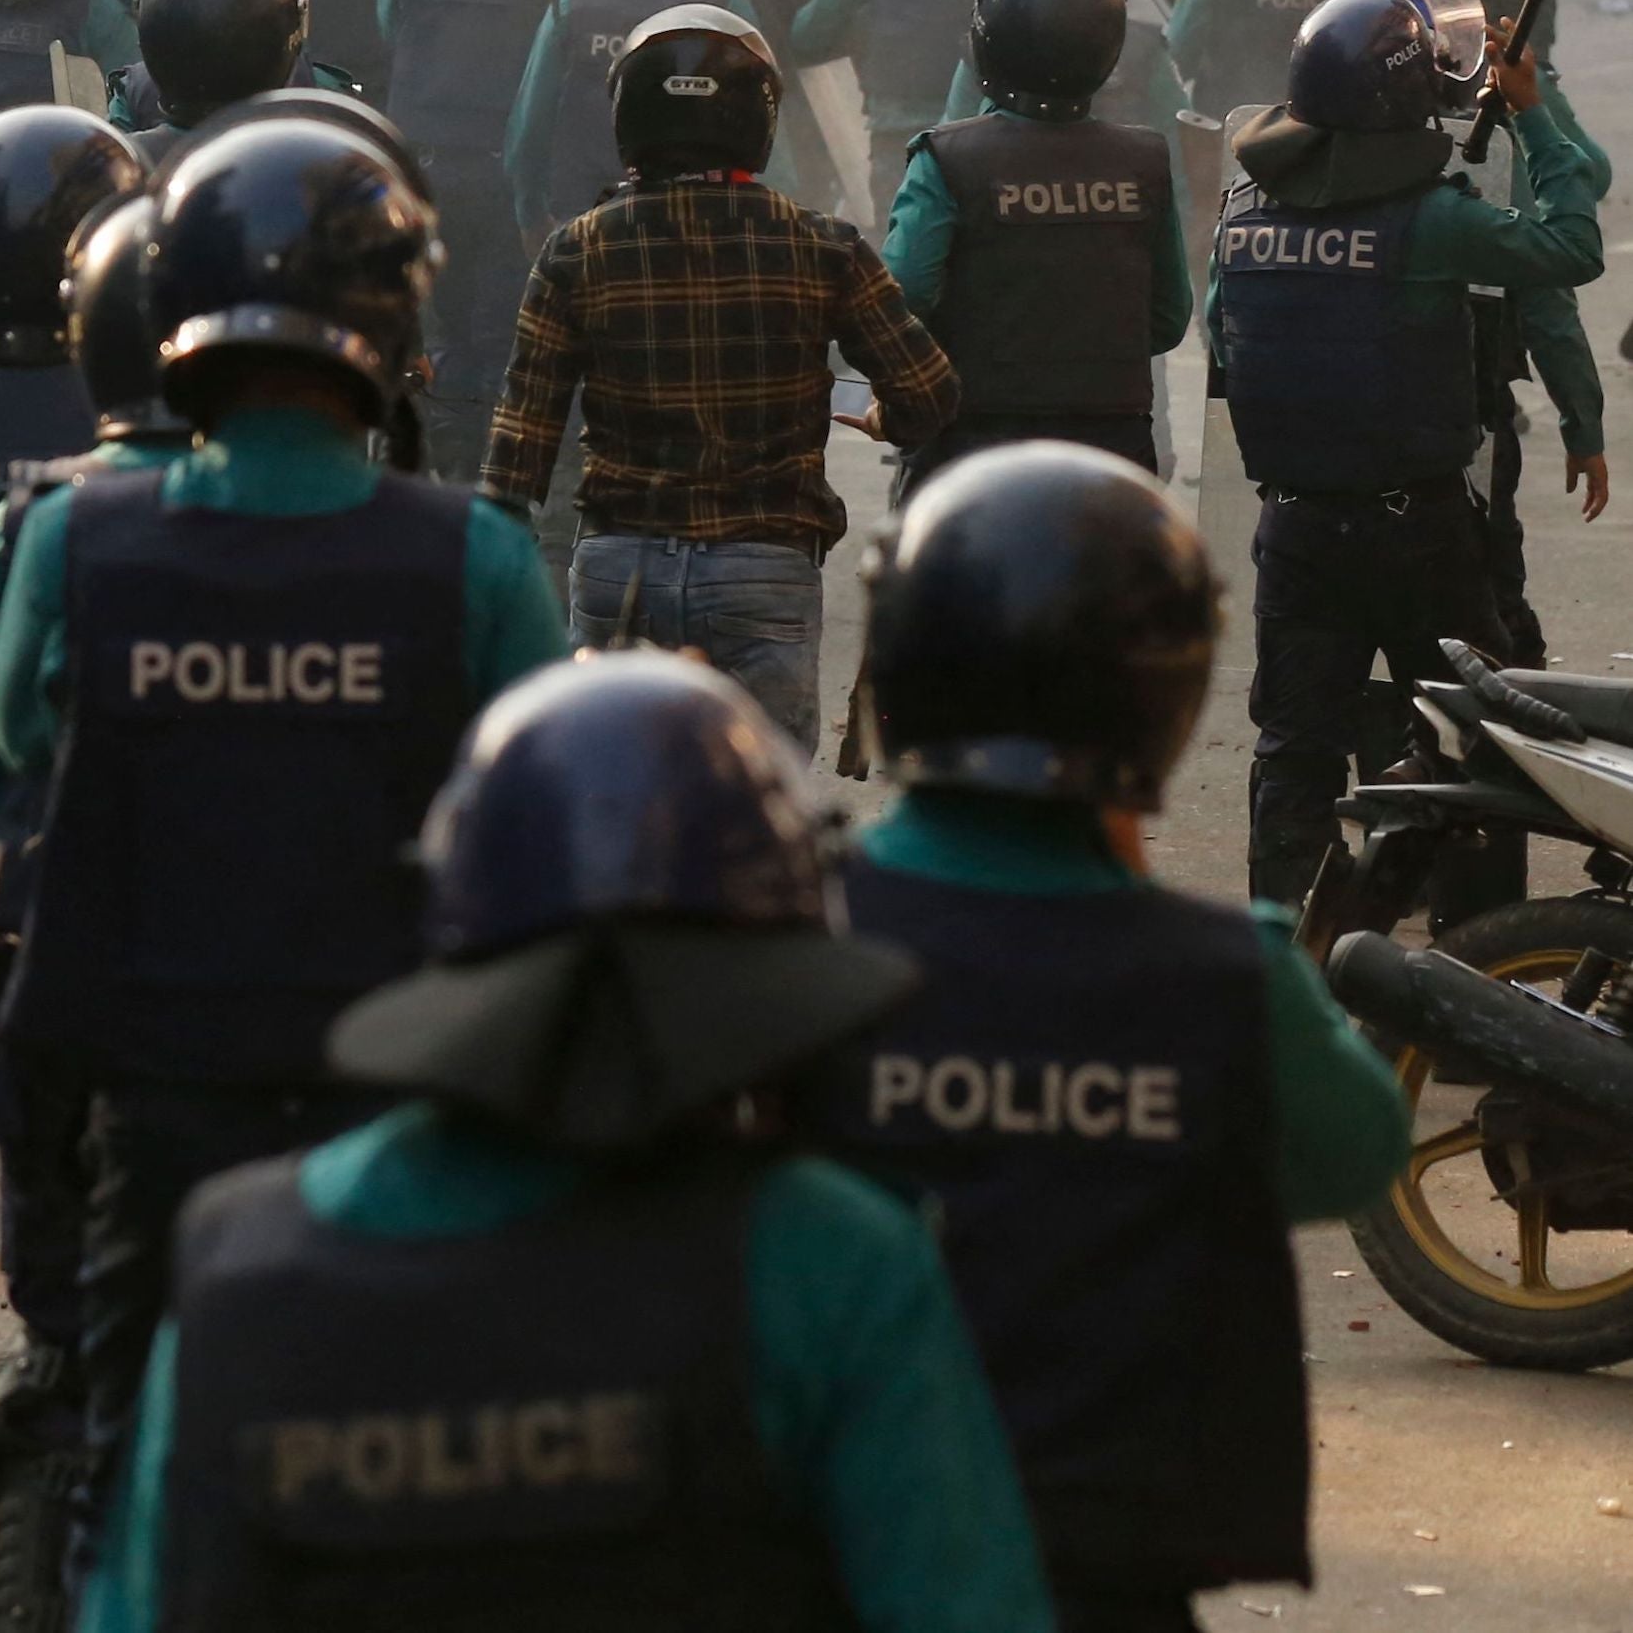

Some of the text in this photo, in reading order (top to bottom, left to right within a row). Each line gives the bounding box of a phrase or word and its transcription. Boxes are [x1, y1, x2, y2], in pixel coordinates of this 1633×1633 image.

[1385, 40, 1422, 71] POLICE
[997, 181, 1141, 216] POLICE
[1222, 227, 1378, 270] POLICE
[130, 641, 383, 703] POLICE
[870, 1053, 1180, 1141] POLICE
[273, 1393, 639, 1504] POLICE
